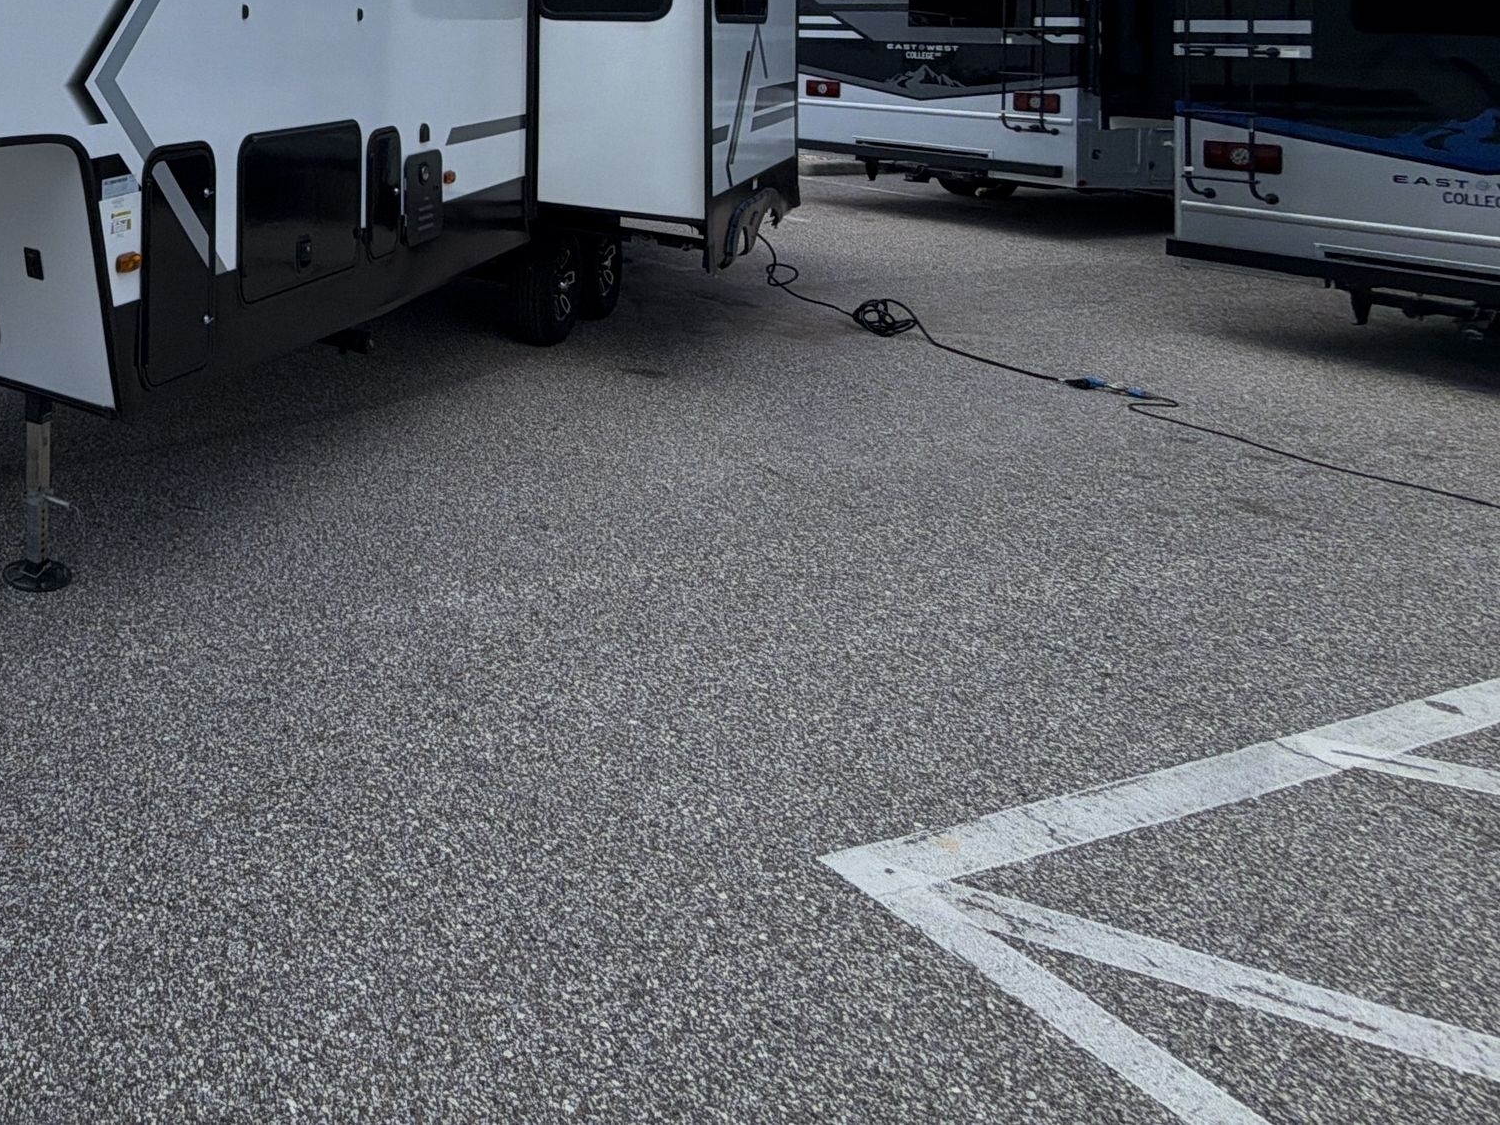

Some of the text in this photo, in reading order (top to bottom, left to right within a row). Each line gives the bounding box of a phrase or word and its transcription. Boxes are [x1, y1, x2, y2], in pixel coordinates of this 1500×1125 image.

[886, 43, 959, 52] EAST WEST
[1392, 175, 1469, 189] EAST
